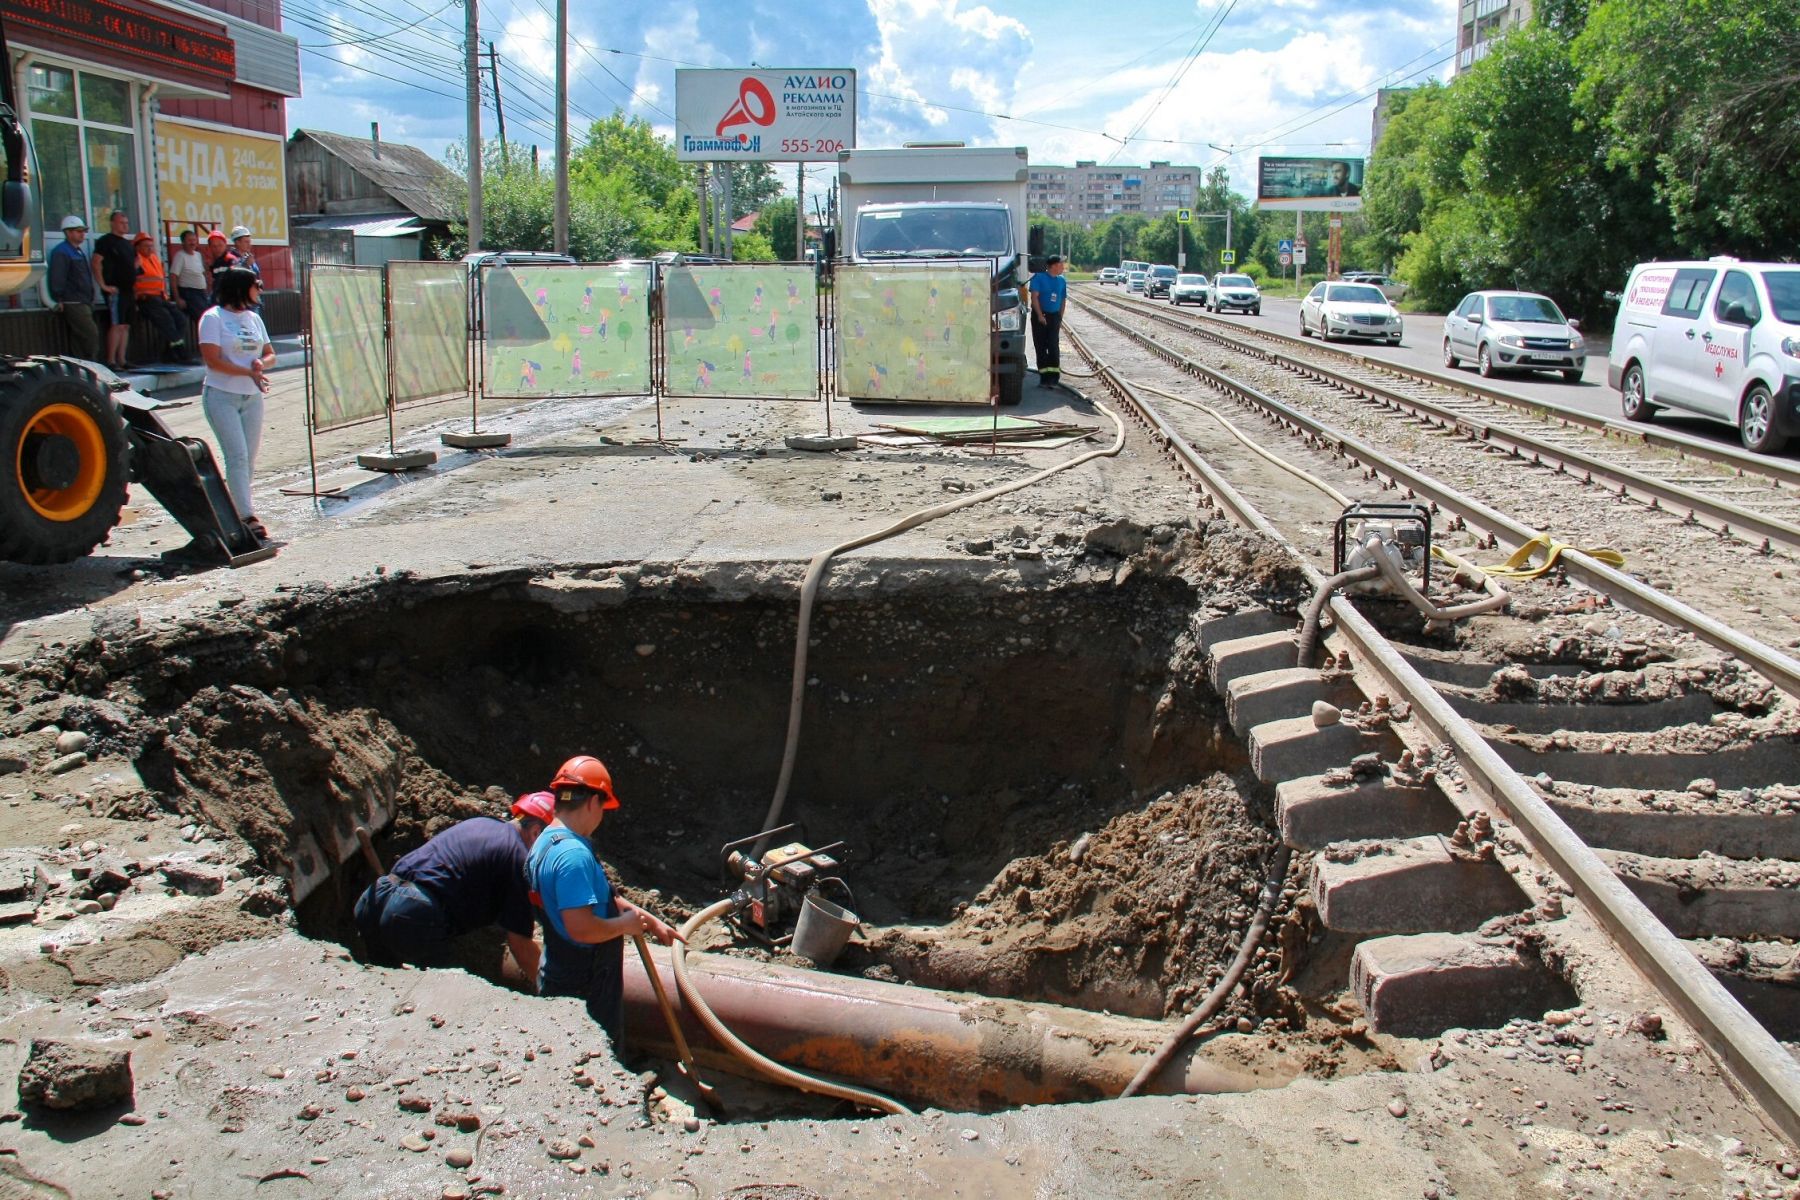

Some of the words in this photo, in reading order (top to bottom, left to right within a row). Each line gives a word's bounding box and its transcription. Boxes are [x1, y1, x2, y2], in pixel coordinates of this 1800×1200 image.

[784, 75, 846, 89] АУДИО
[783, 93, 844, 104] РЕКЛАМА
[781, 139, 844, 153] 555-206
[233, 168, 242, 188] 2
[246, 174, 278, 190] этаж
[232, 205, 279, 235] 8212
[1705, 343, 1738, 359] МЕДСЛУЖБА
